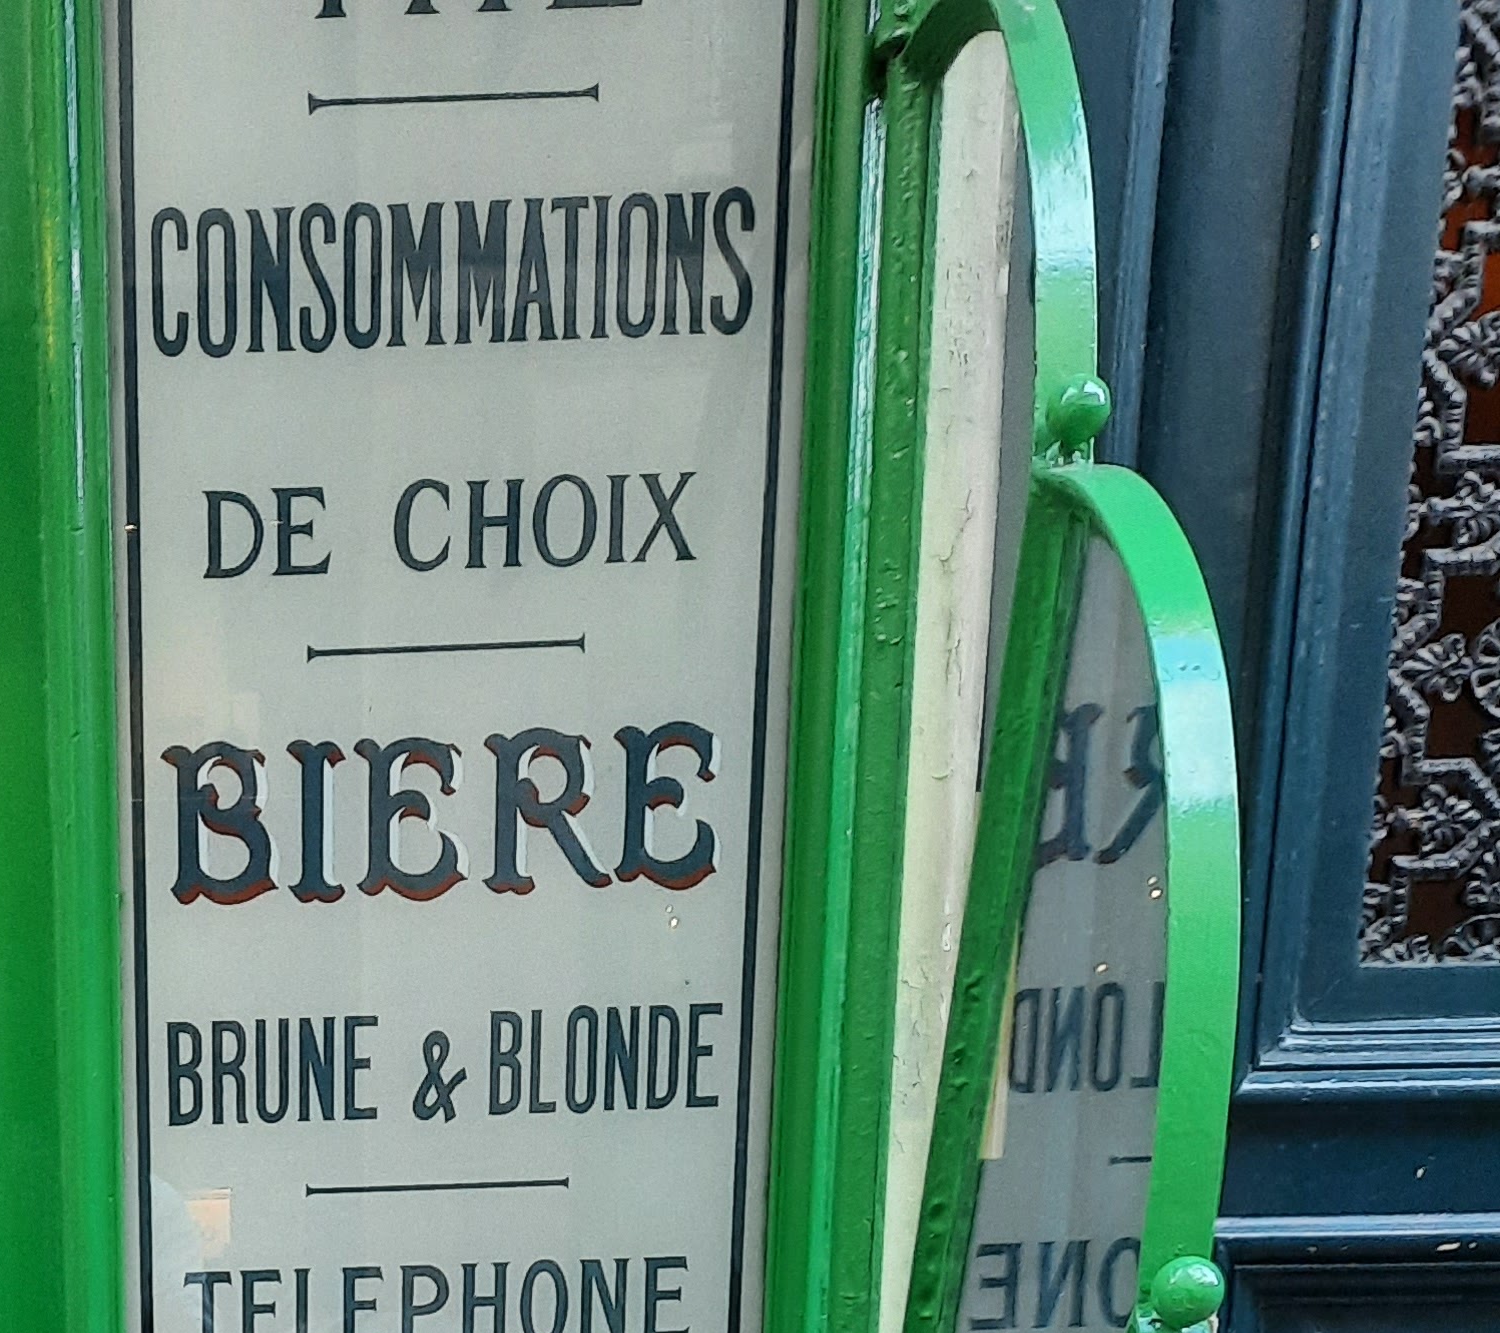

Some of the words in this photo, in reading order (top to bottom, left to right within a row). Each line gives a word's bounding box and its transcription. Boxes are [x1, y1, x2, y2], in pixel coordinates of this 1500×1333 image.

[150, 186, 756, 358] CONSOMMATIONS
[202, 486, 333, 579] DE
[393, 471, 698, 573] CHOIX
[160, 720, 720, 906] BIERE
[165, 1014, 380, 1127] BRUNE
[412, 1029, 468, 1125] &
[488, 1002, 725, 1117] BLONDE
